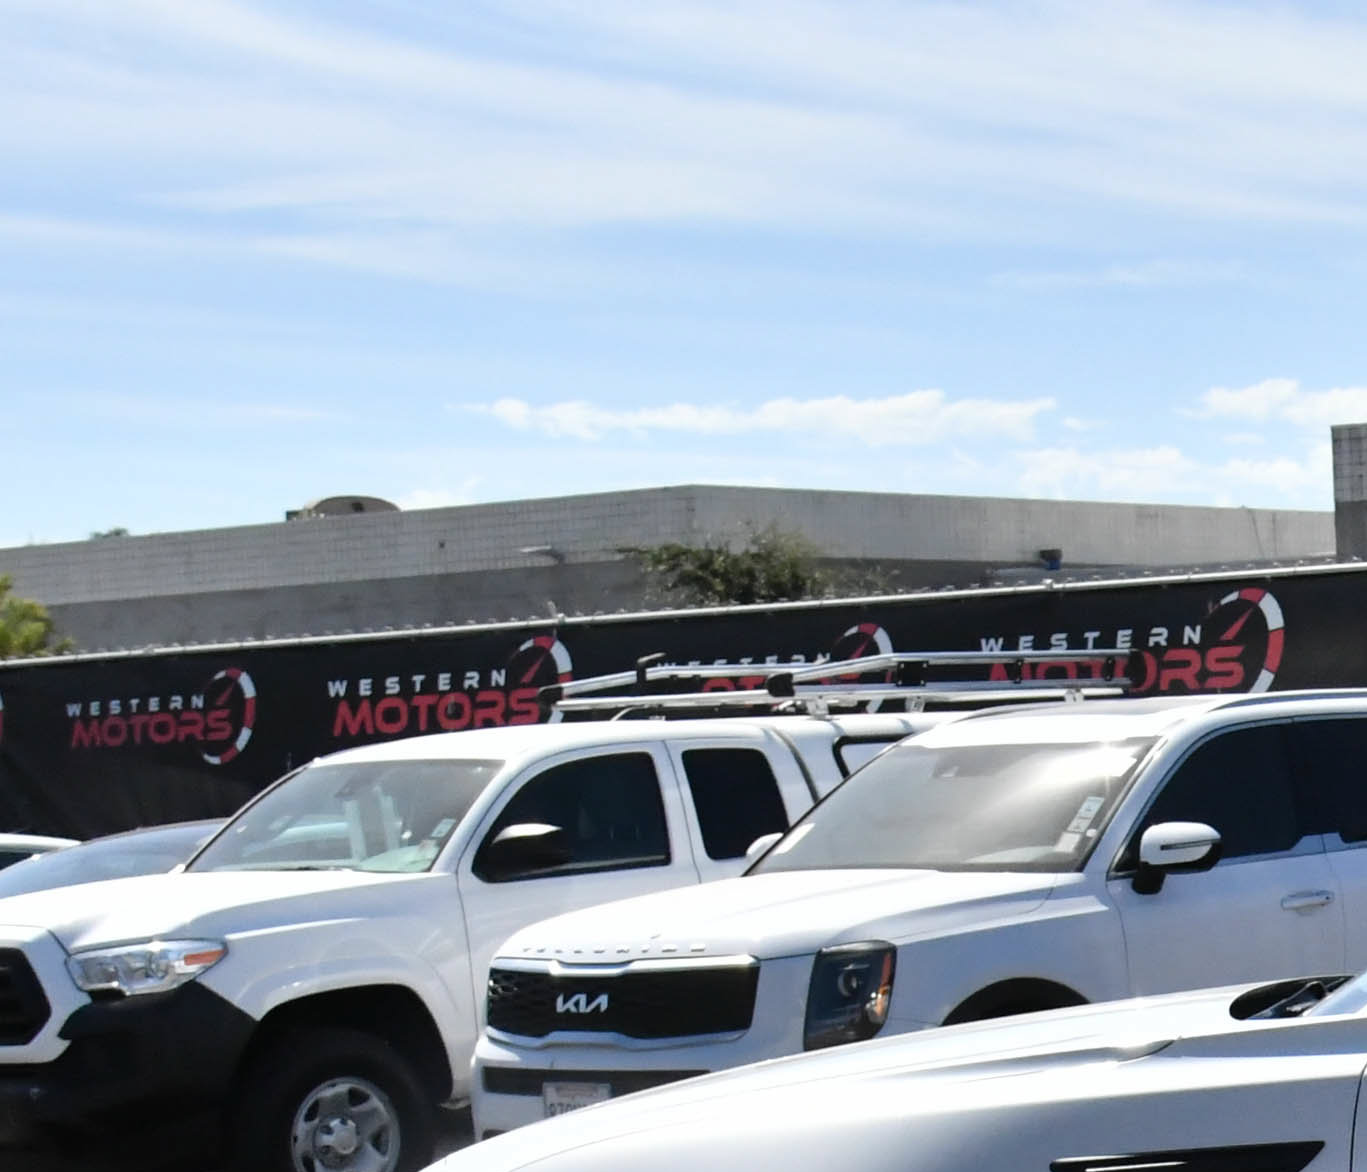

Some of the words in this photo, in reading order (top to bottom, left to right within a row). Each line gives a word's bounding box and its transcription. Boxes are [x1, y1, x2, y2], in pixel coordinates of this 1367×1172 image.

[980, 624, 1202, 653] WESTERN
[327, 669, 506, 699] WESTERN
[66, 694, 205, 718] WESTERN
[333, 686, 541, 737] MOTORS
[71, 708, 234, 749] MOTORS
[555, 992, 609, 1014] KIA
